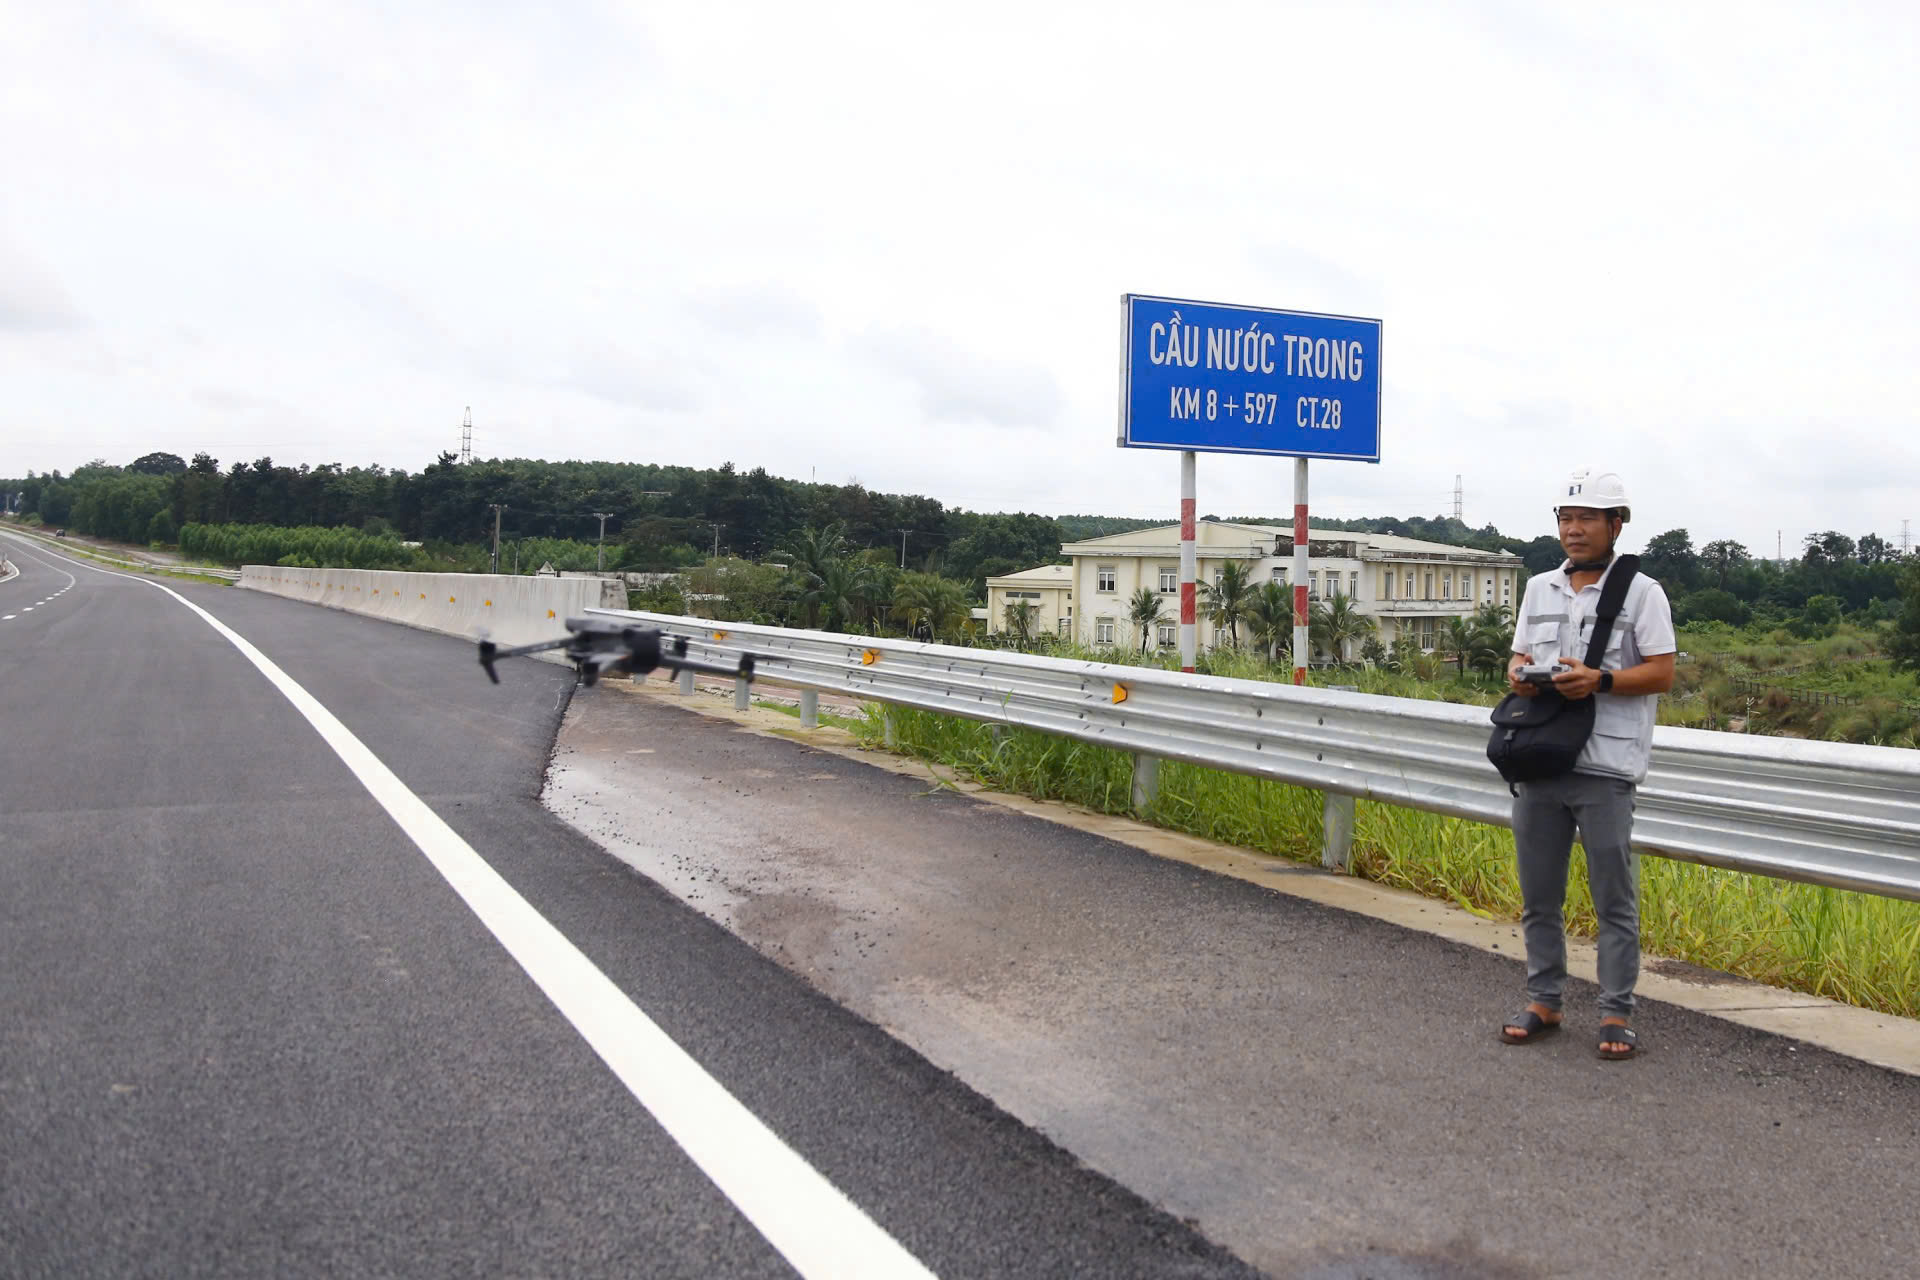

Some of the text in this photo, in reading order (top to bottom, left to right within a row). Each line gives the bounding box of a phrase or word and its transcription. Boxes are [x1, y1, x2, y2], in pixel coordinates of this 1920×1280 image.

[1150, 310, 1363, 382] CẦU NƯỚC TRONG
[1170, 386, 1342, 430] KM 8 + 597 CT.28
